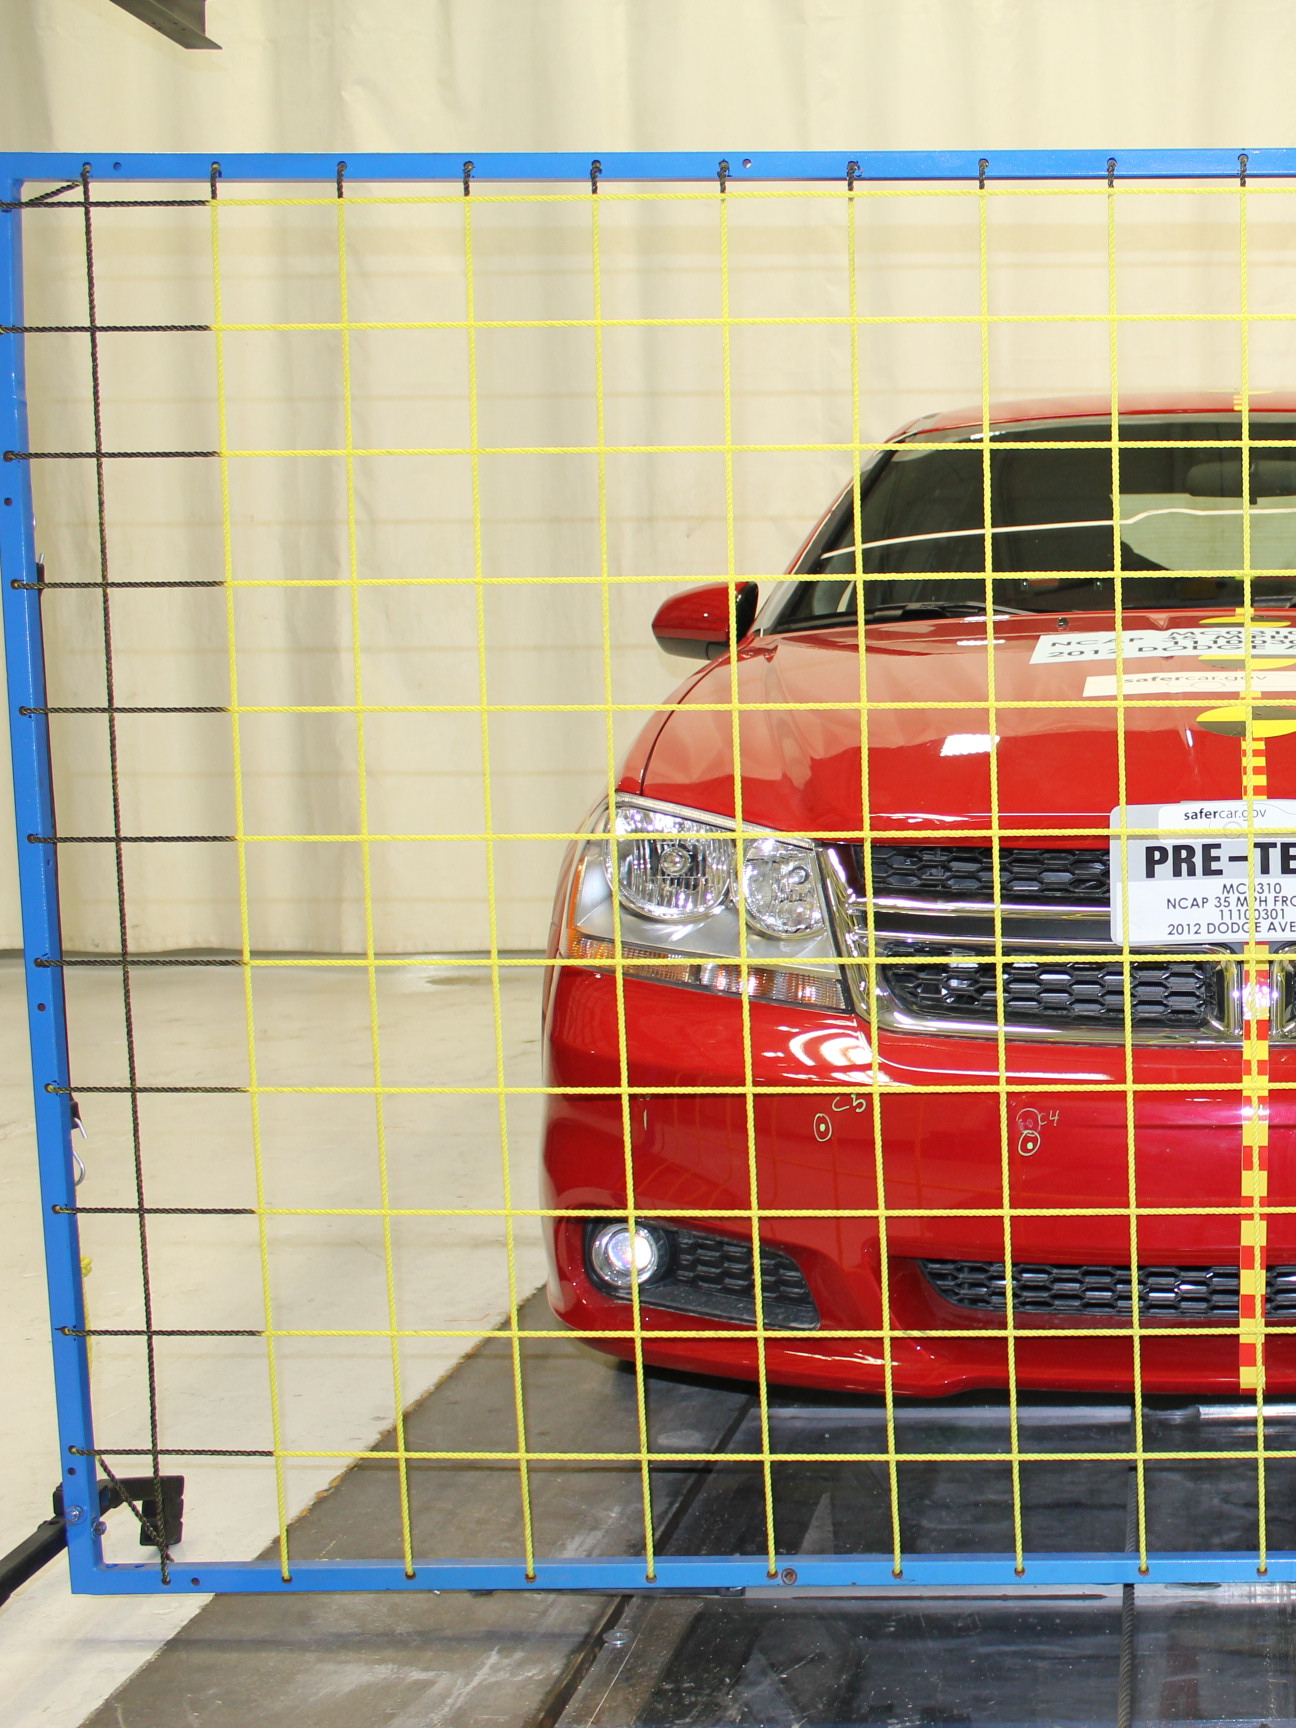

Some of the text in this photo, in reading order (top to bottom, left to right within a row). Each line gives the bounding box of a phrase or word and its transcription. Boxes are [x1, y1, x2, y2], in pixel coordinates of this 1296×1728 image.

[1051, 637, 1144, 647] NCAP
[1138, 644, 1266, 652] DODGE
[1184, 807, 1267, 821] safercar.gov
[1222, 882, 1282, 895] MC310
[1166, 897, 1209, 910] NCAP
[1214, 896, 1231, 908] 35
[1167, 923, 1202, 936] 2012
[1207, 921, 1262, 934] DODGE
